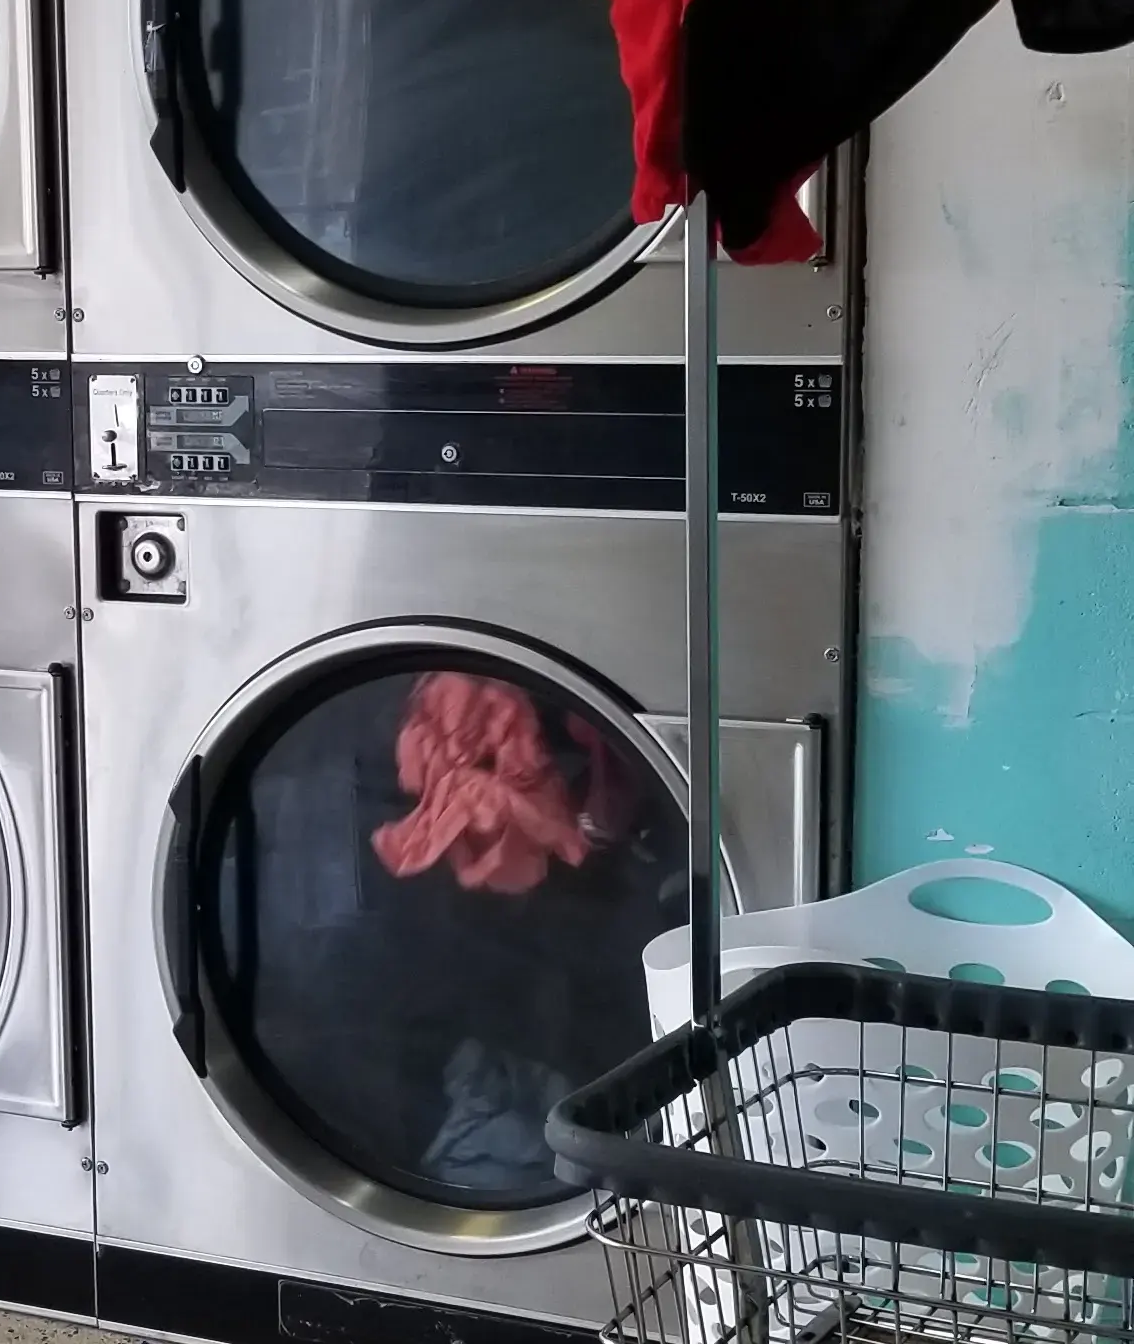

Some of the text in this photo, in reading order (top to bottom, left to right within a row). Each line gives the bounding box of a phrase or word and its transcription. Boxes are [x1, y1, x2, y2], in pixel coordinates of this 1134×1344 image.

[31, 367, 39, 380] 5
[794, 374, 804, 388] 5
[32, 385, 40, 397] 5
[794, 394, 804, 407] 5
[730, 492, 767, 504] T-50X2
